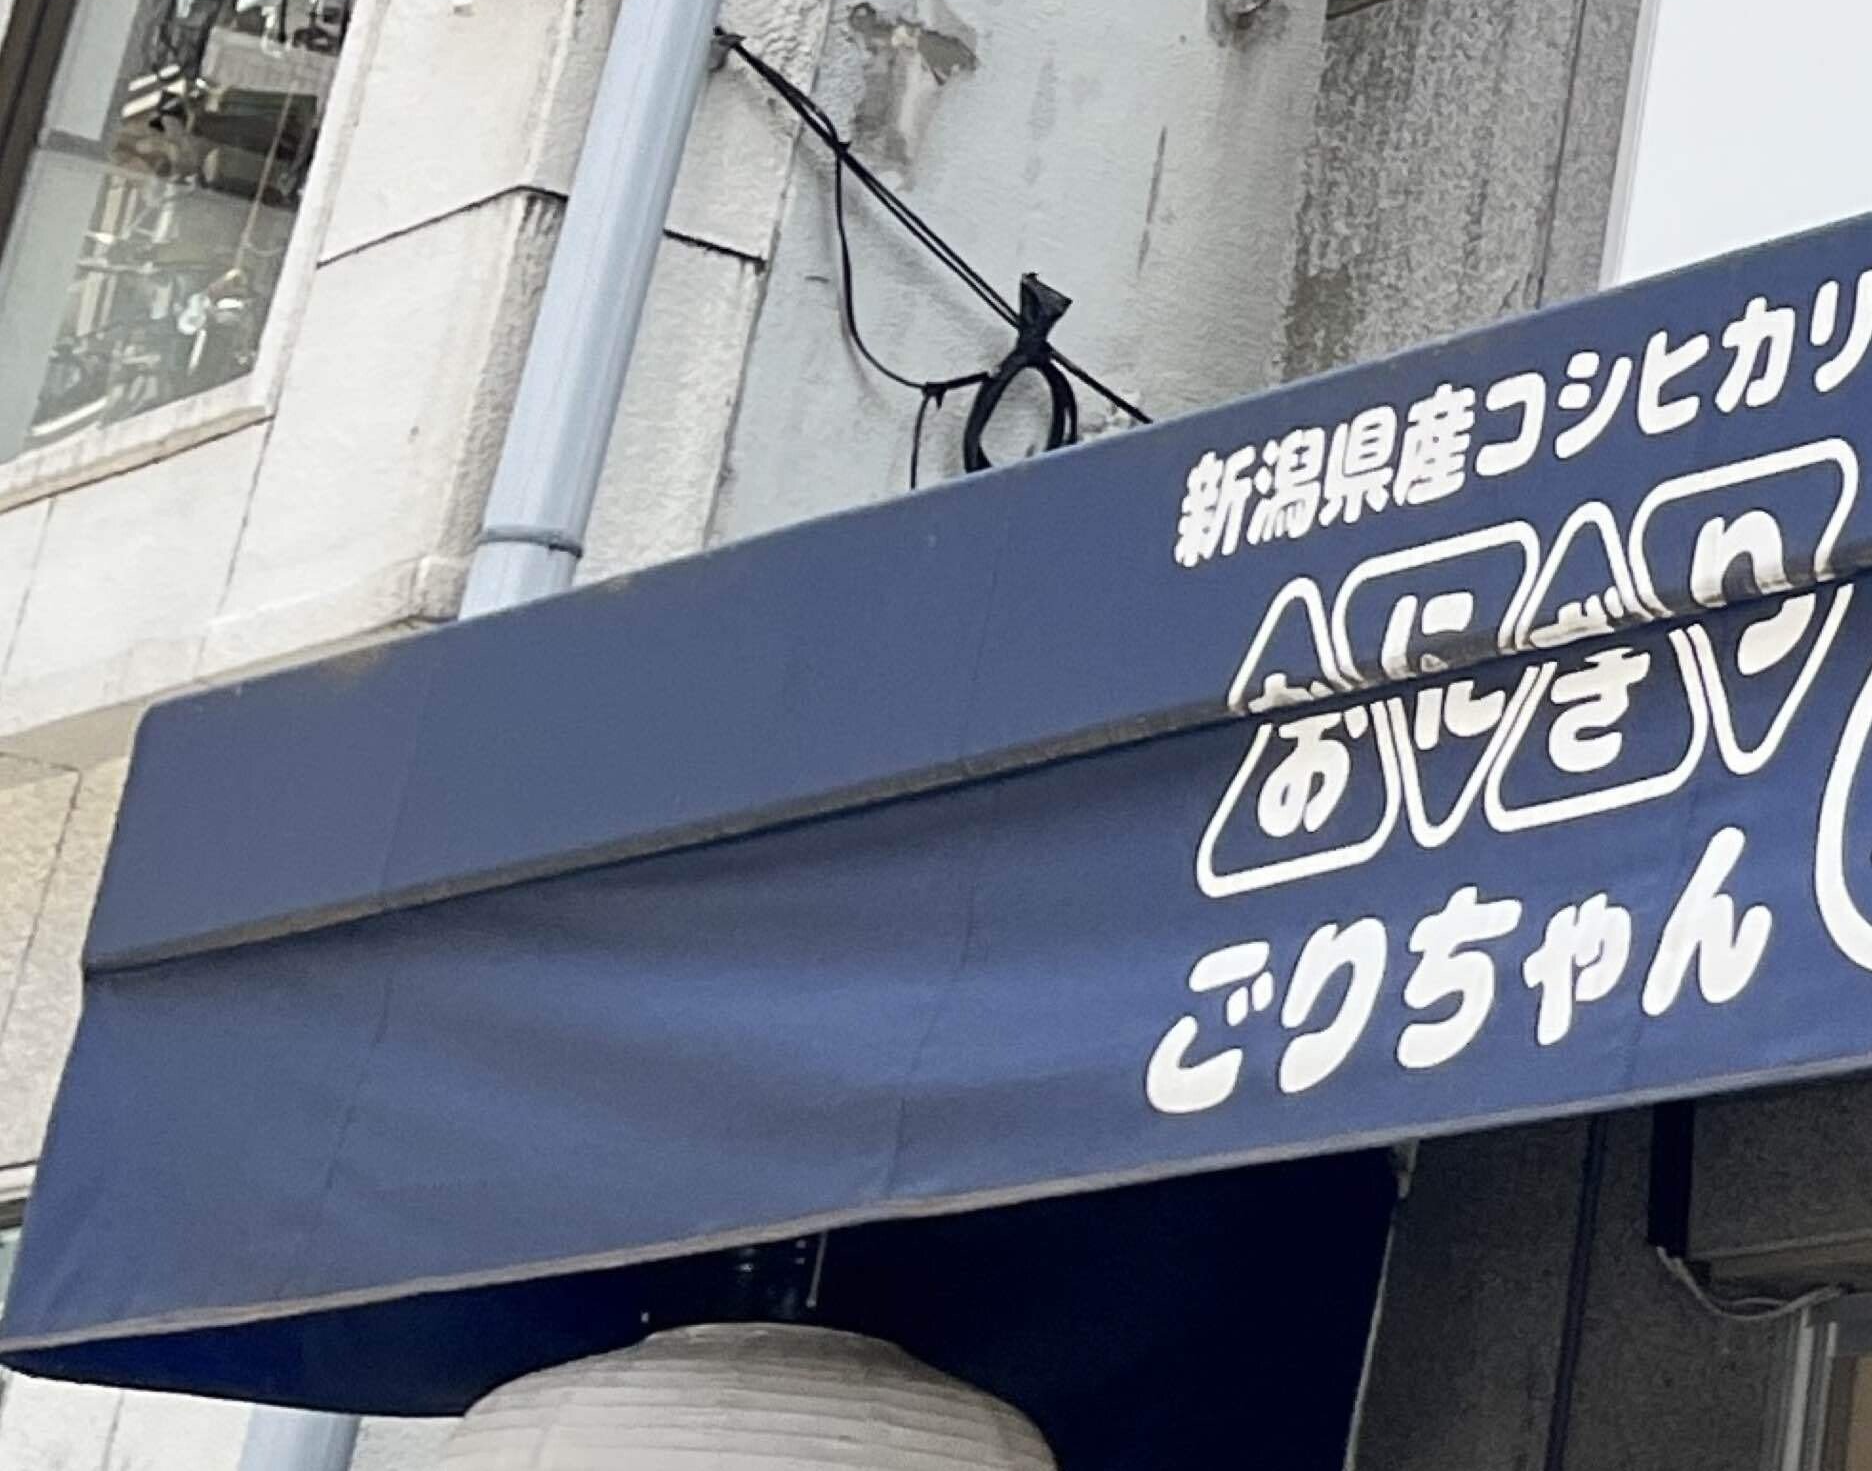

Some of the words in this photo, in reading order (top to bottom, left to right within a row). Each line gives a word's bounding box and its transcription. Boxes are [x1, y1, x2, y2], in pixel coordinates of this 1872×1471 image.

[1247, 509, 1817, 839] おにぎり
[1145, 826, 1774, 1115] ごりちゃん
